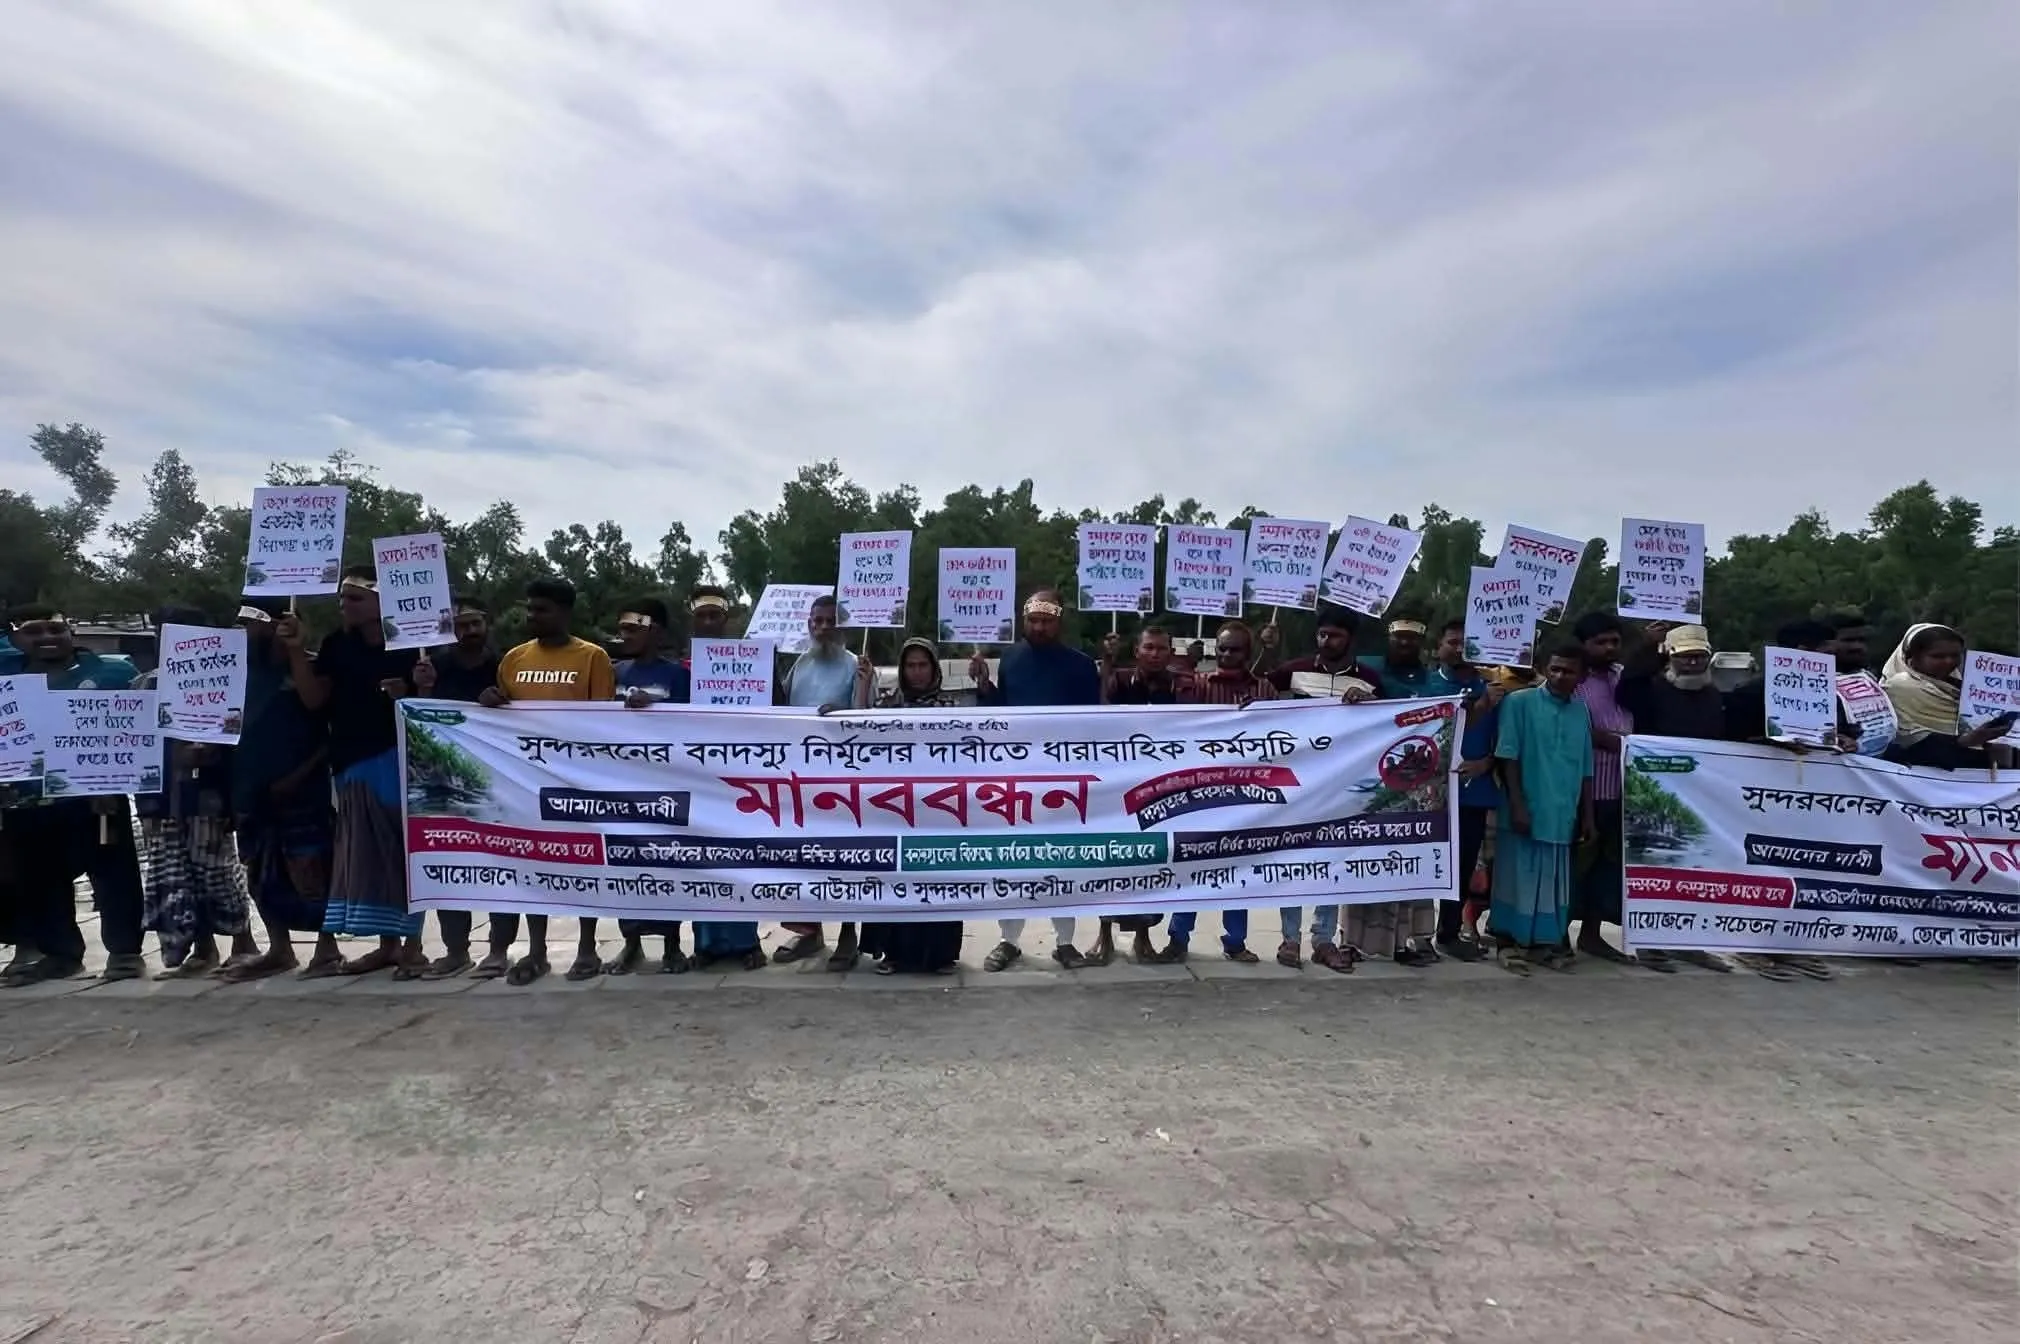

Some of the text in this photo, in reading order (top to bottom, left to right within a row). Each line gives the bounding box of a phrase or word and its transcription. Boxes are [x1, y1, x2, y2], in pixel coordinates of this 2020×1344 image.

[516, 731, 1333, 771] সুন্দরবনের বনদস্যু নির্মূলের দাবীতে ধারাবাহিক কর্মসূচি ও
[547, 796, 679, 819] আমাদের দাবী
[716, 770, 1102, 829] মানববন্ধন
[1741, 786, 1893, 817] সুন্দরবনের
[1751, 840, 1874, 868] আমাদের দাবী
[423, 864, 517, 886] আয়োজনে
[535, 872, 600, 894] সচেতন
[605, 873, 676, 896] নাগরিক
[751, 881, 802, 901] জেলে
[807, 876, 885, 901] বাউয়ালী
[893, 884, 908, 900] ও
[913, 881, 986, 904] সুন্দরবন
[992, 875, 1075, 902] উপকূলীয়
[1344, 850, 1423, 880] সাতক্ষীরা
[1714, 912, 1775, 937] সচেতন
[1782, 917, 1848, 940] নাগরিক
